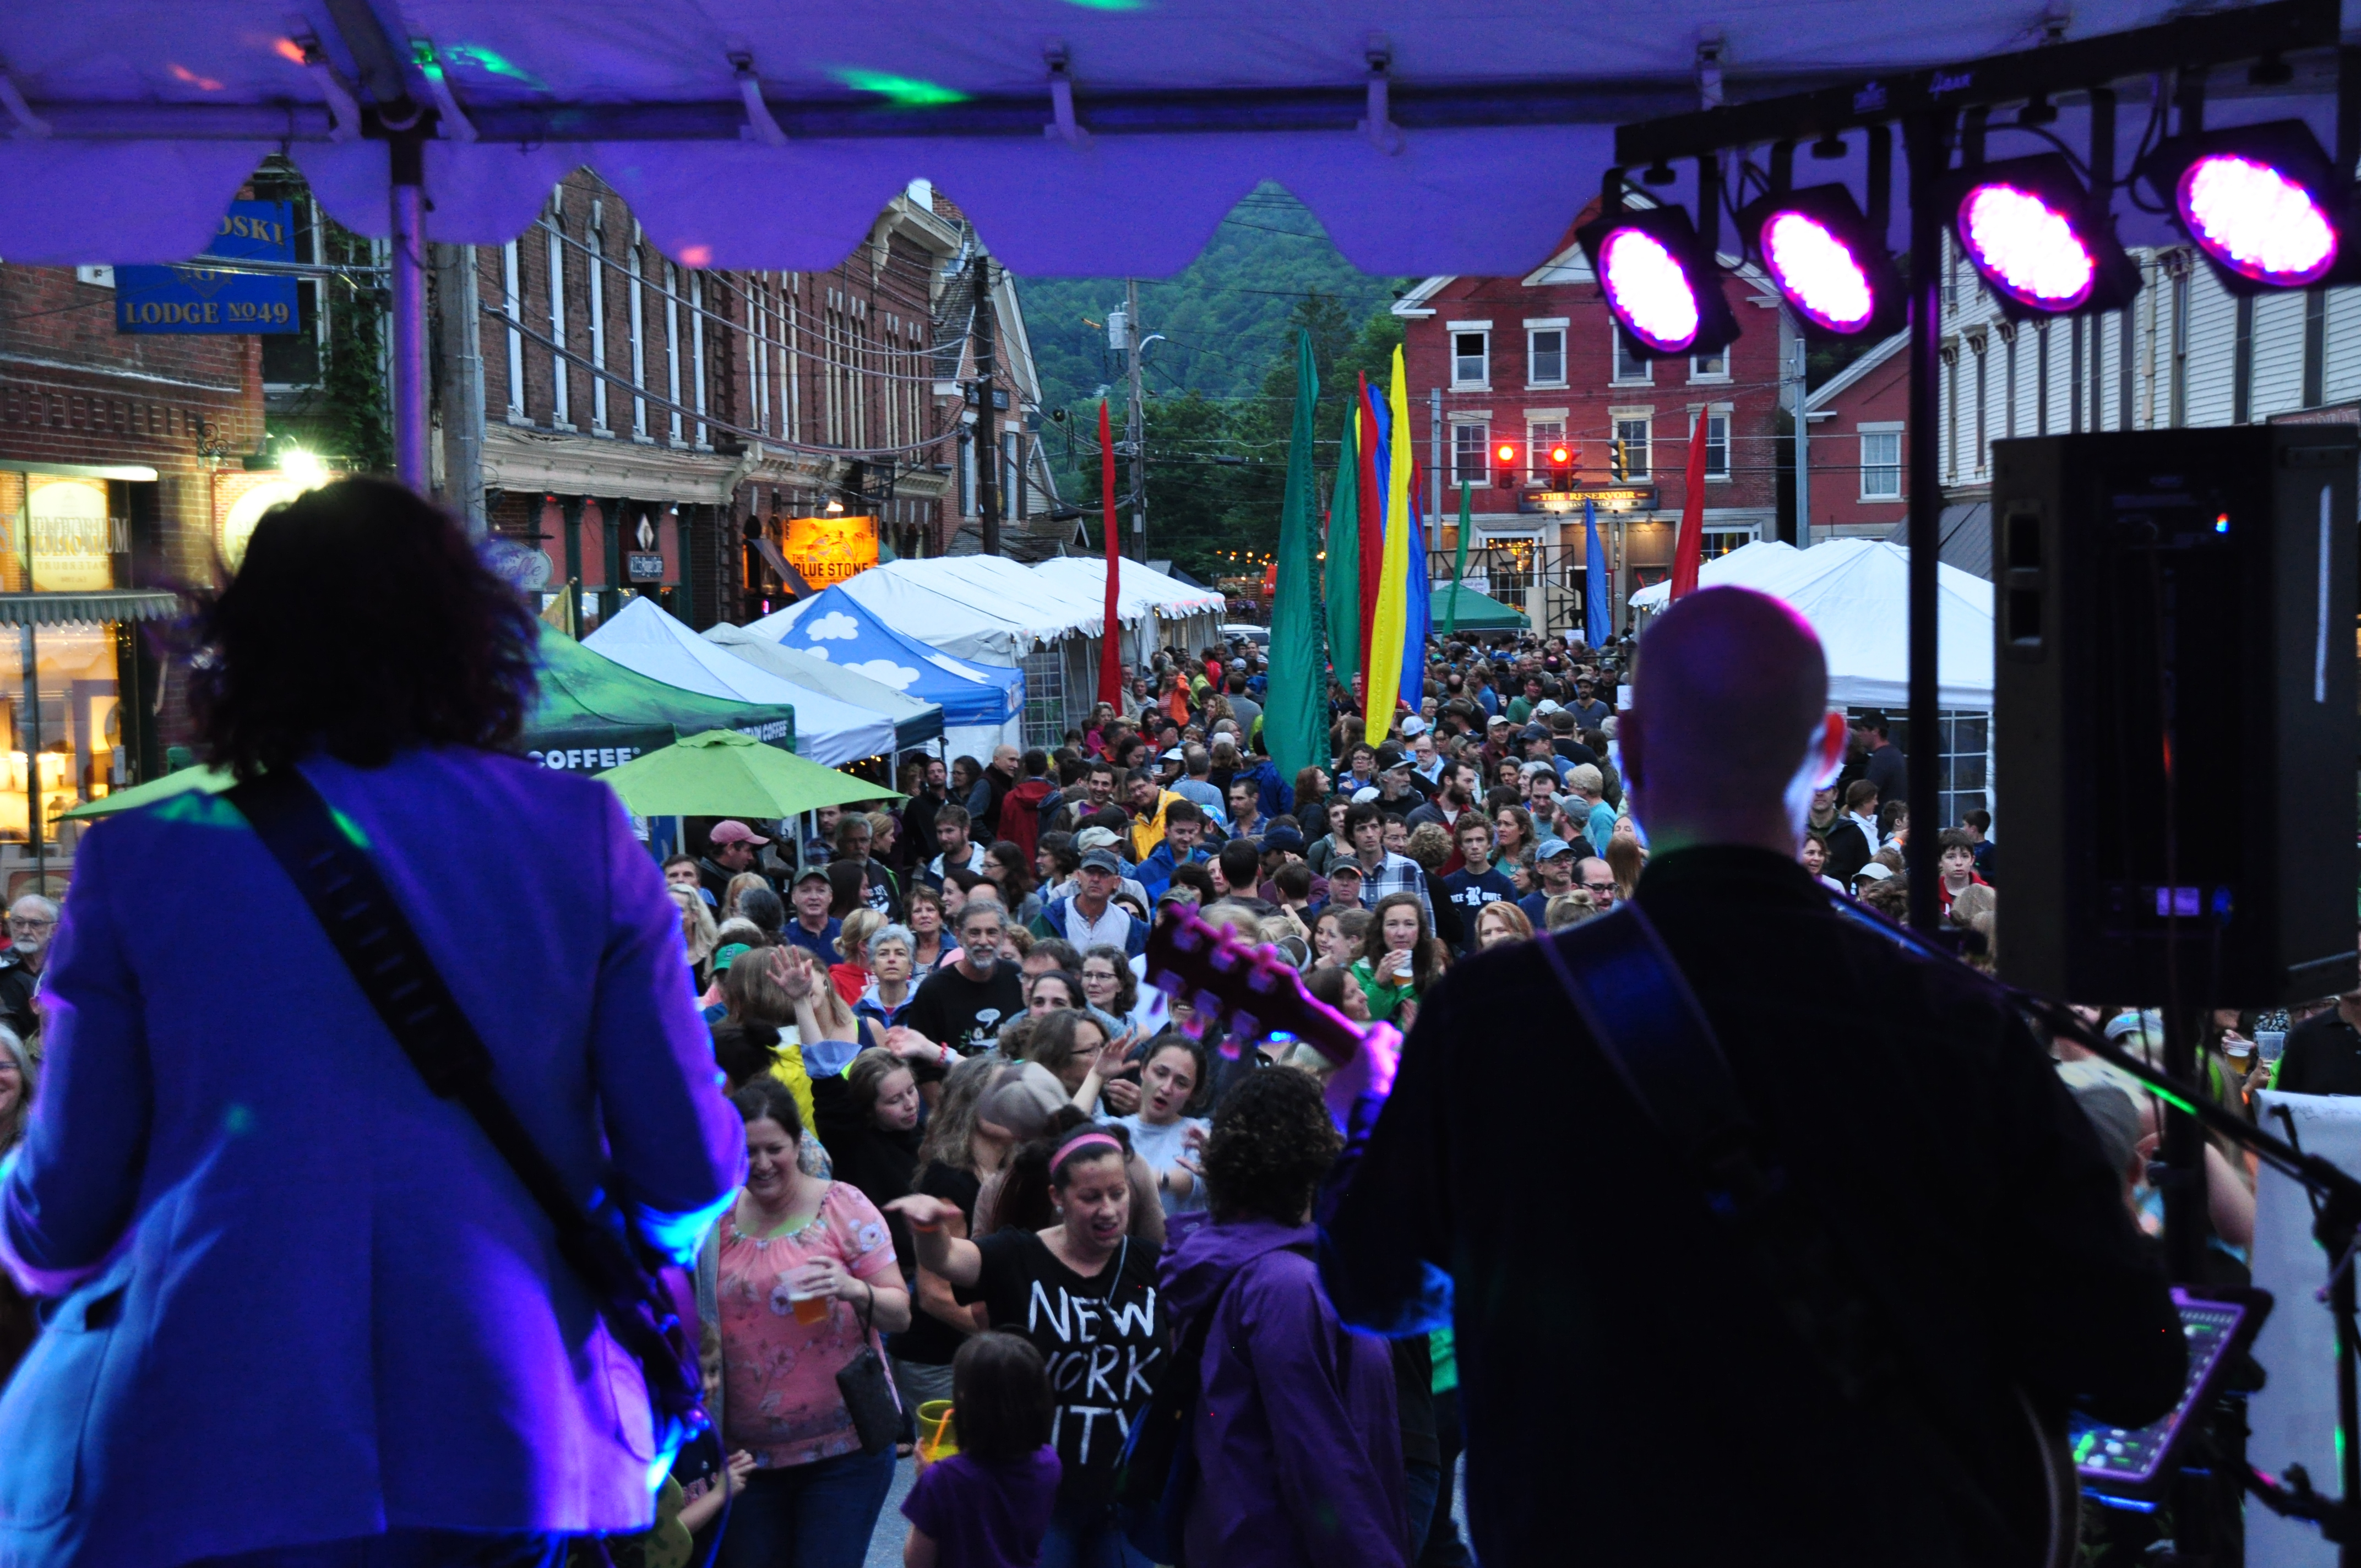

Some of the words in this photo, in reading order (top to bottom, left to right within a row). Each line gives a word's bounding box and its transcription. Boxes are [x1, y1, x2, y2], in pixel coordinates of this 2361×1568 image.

[217, 216, 285, 246] OSKI
[126, 302, 219, 324] LODGE
[1541, 492, 1566, 500] THE
[1569, 491, 1636, 501] RESERVOIR
[794, 563, 824, 576] BLUE
[763, 720, 787, 741] COFFEE
[1482, 892, 1502, 902] OWLS
[1029, 1280, 1156, 1343] NEW
[1051, 1404, 1133, 1469] ITY
